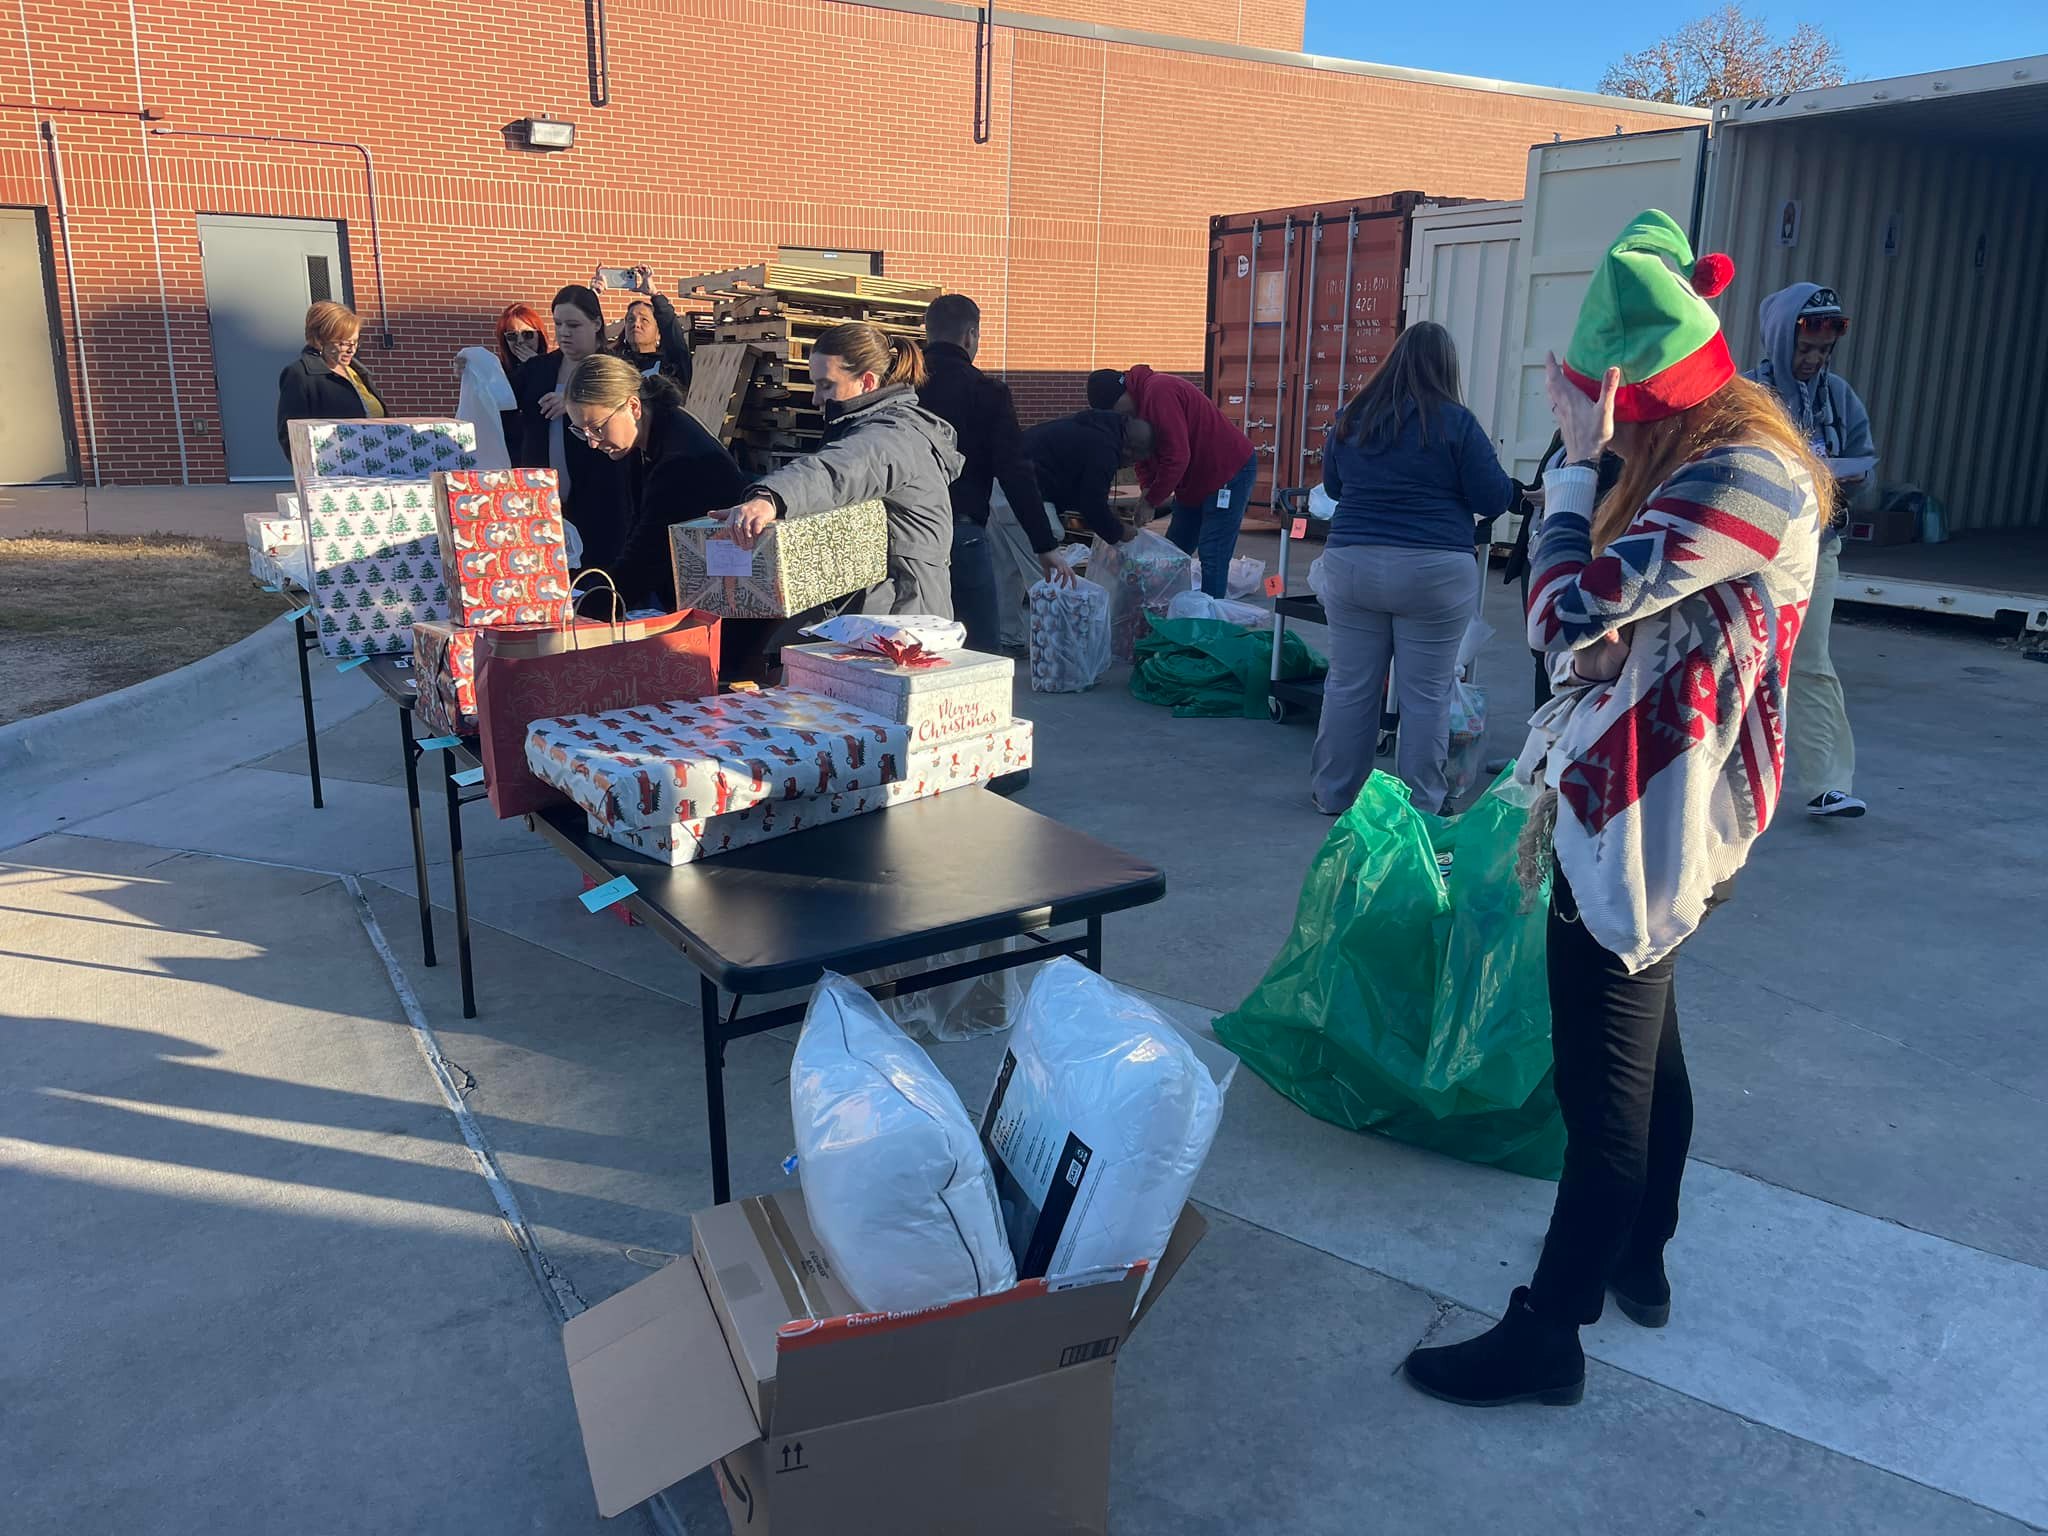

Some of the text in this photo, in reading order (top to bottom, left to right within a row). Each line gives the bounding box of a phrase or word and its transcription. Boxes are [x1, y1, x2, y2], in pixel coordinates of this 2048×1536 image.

[938, 698, 979, 719] Merry
[918, 710, 997, 741] Christmas
[846, 1313, 885, 1328] Cheer
